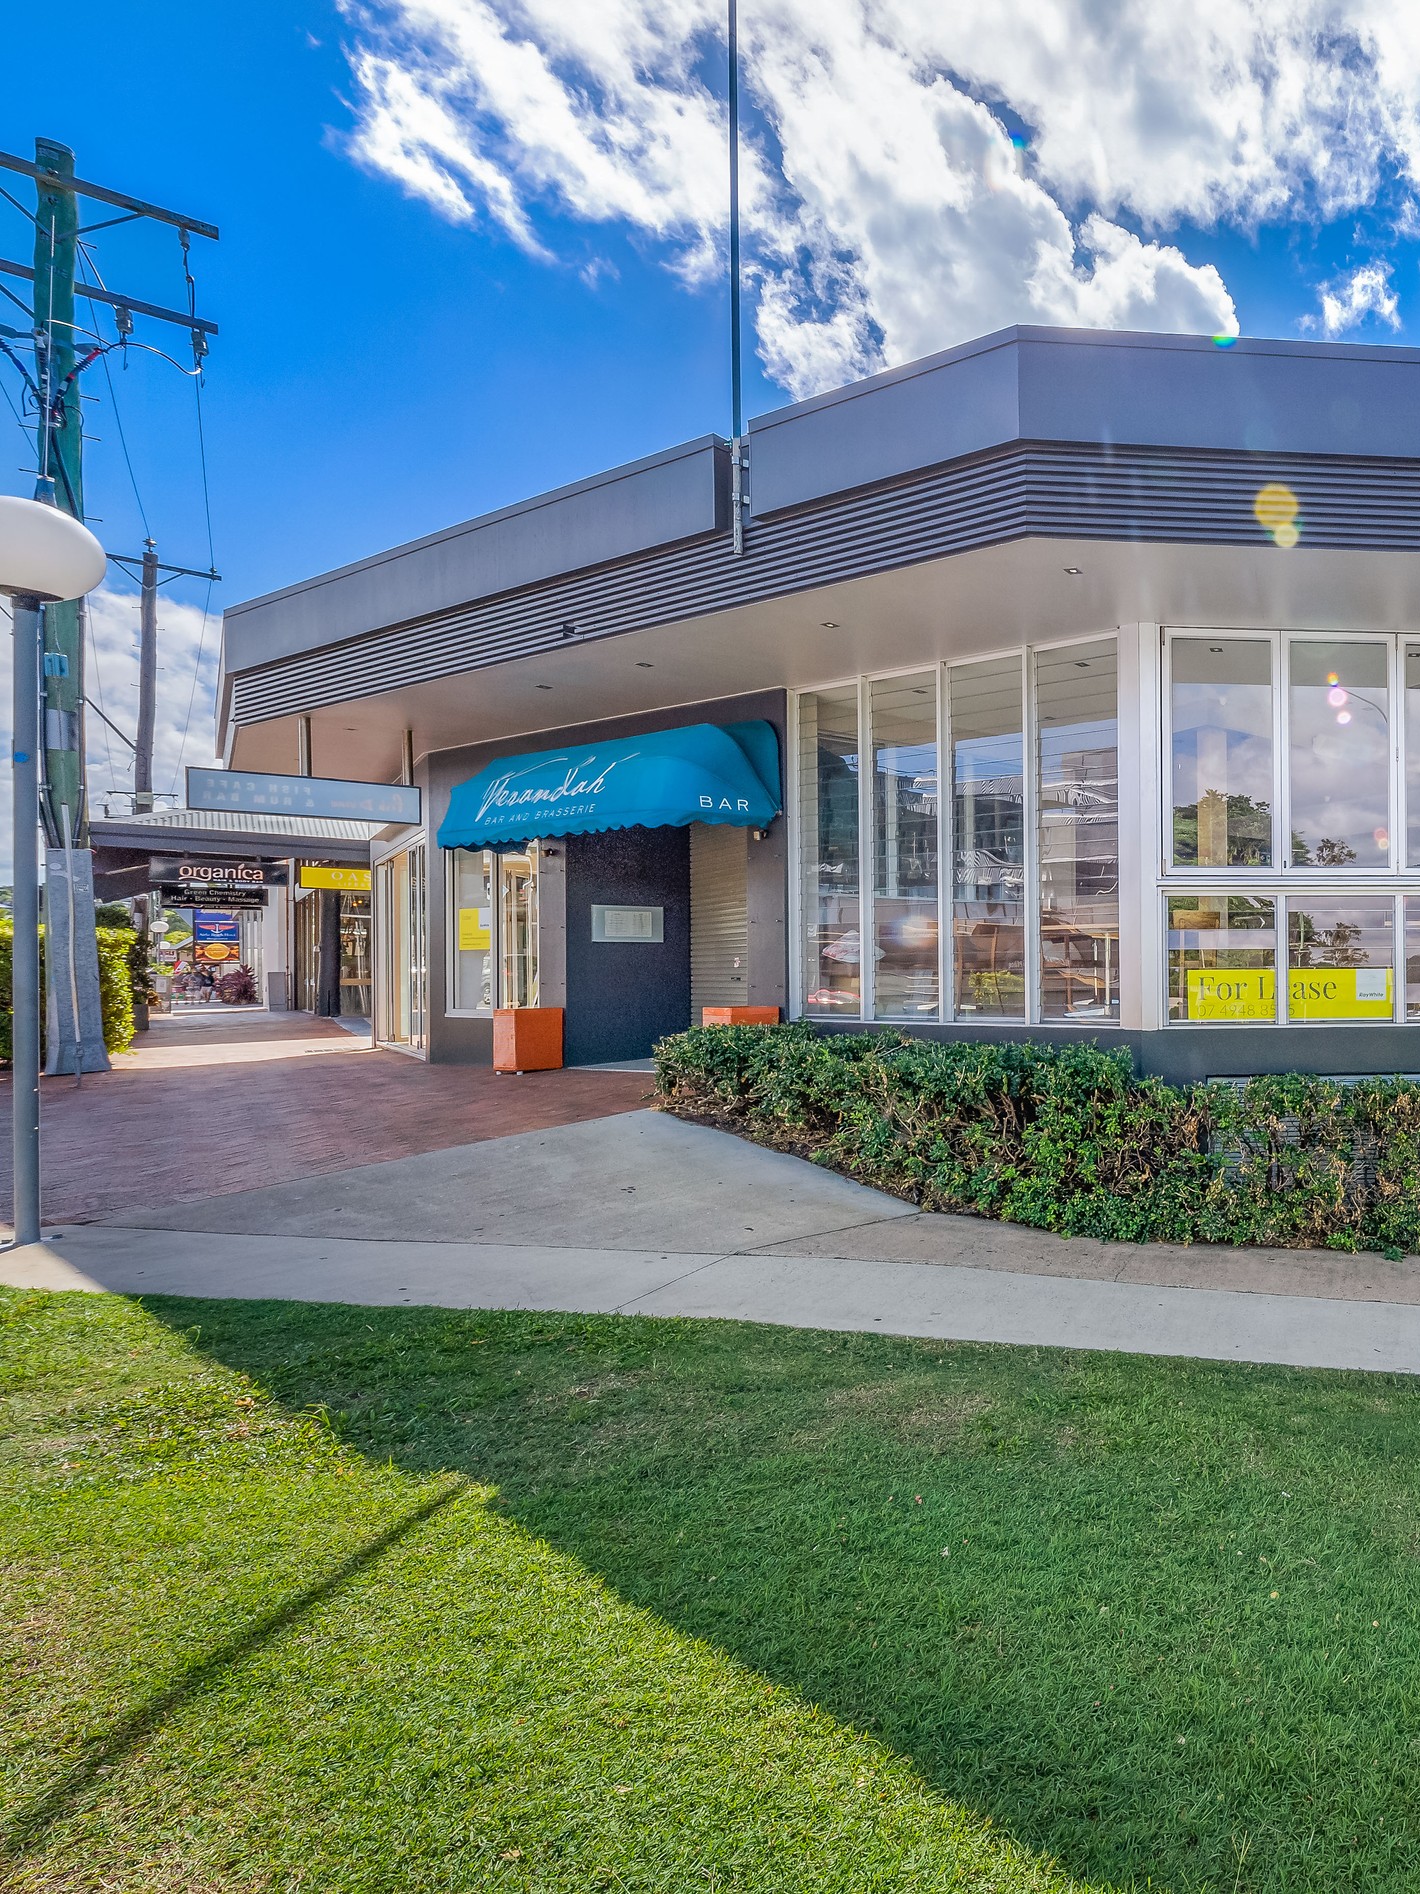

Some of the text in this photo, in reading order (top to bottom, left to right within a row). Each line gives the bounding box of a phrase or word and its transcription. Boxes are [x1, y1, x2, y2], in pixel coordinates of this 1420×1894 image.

[475, 752, 640, 822] Verandah
[699, 795, 749, 812] BAR
[484, 803, 596, 826] BAR AND BRASSERIE
[178, 863, 264, 881] organica
[209, 889, 246, 898] Chemistry
[1198, 976, 1337, 1000] For Lase
[1197, 1004, 1295, 1017] 07 4948 855
